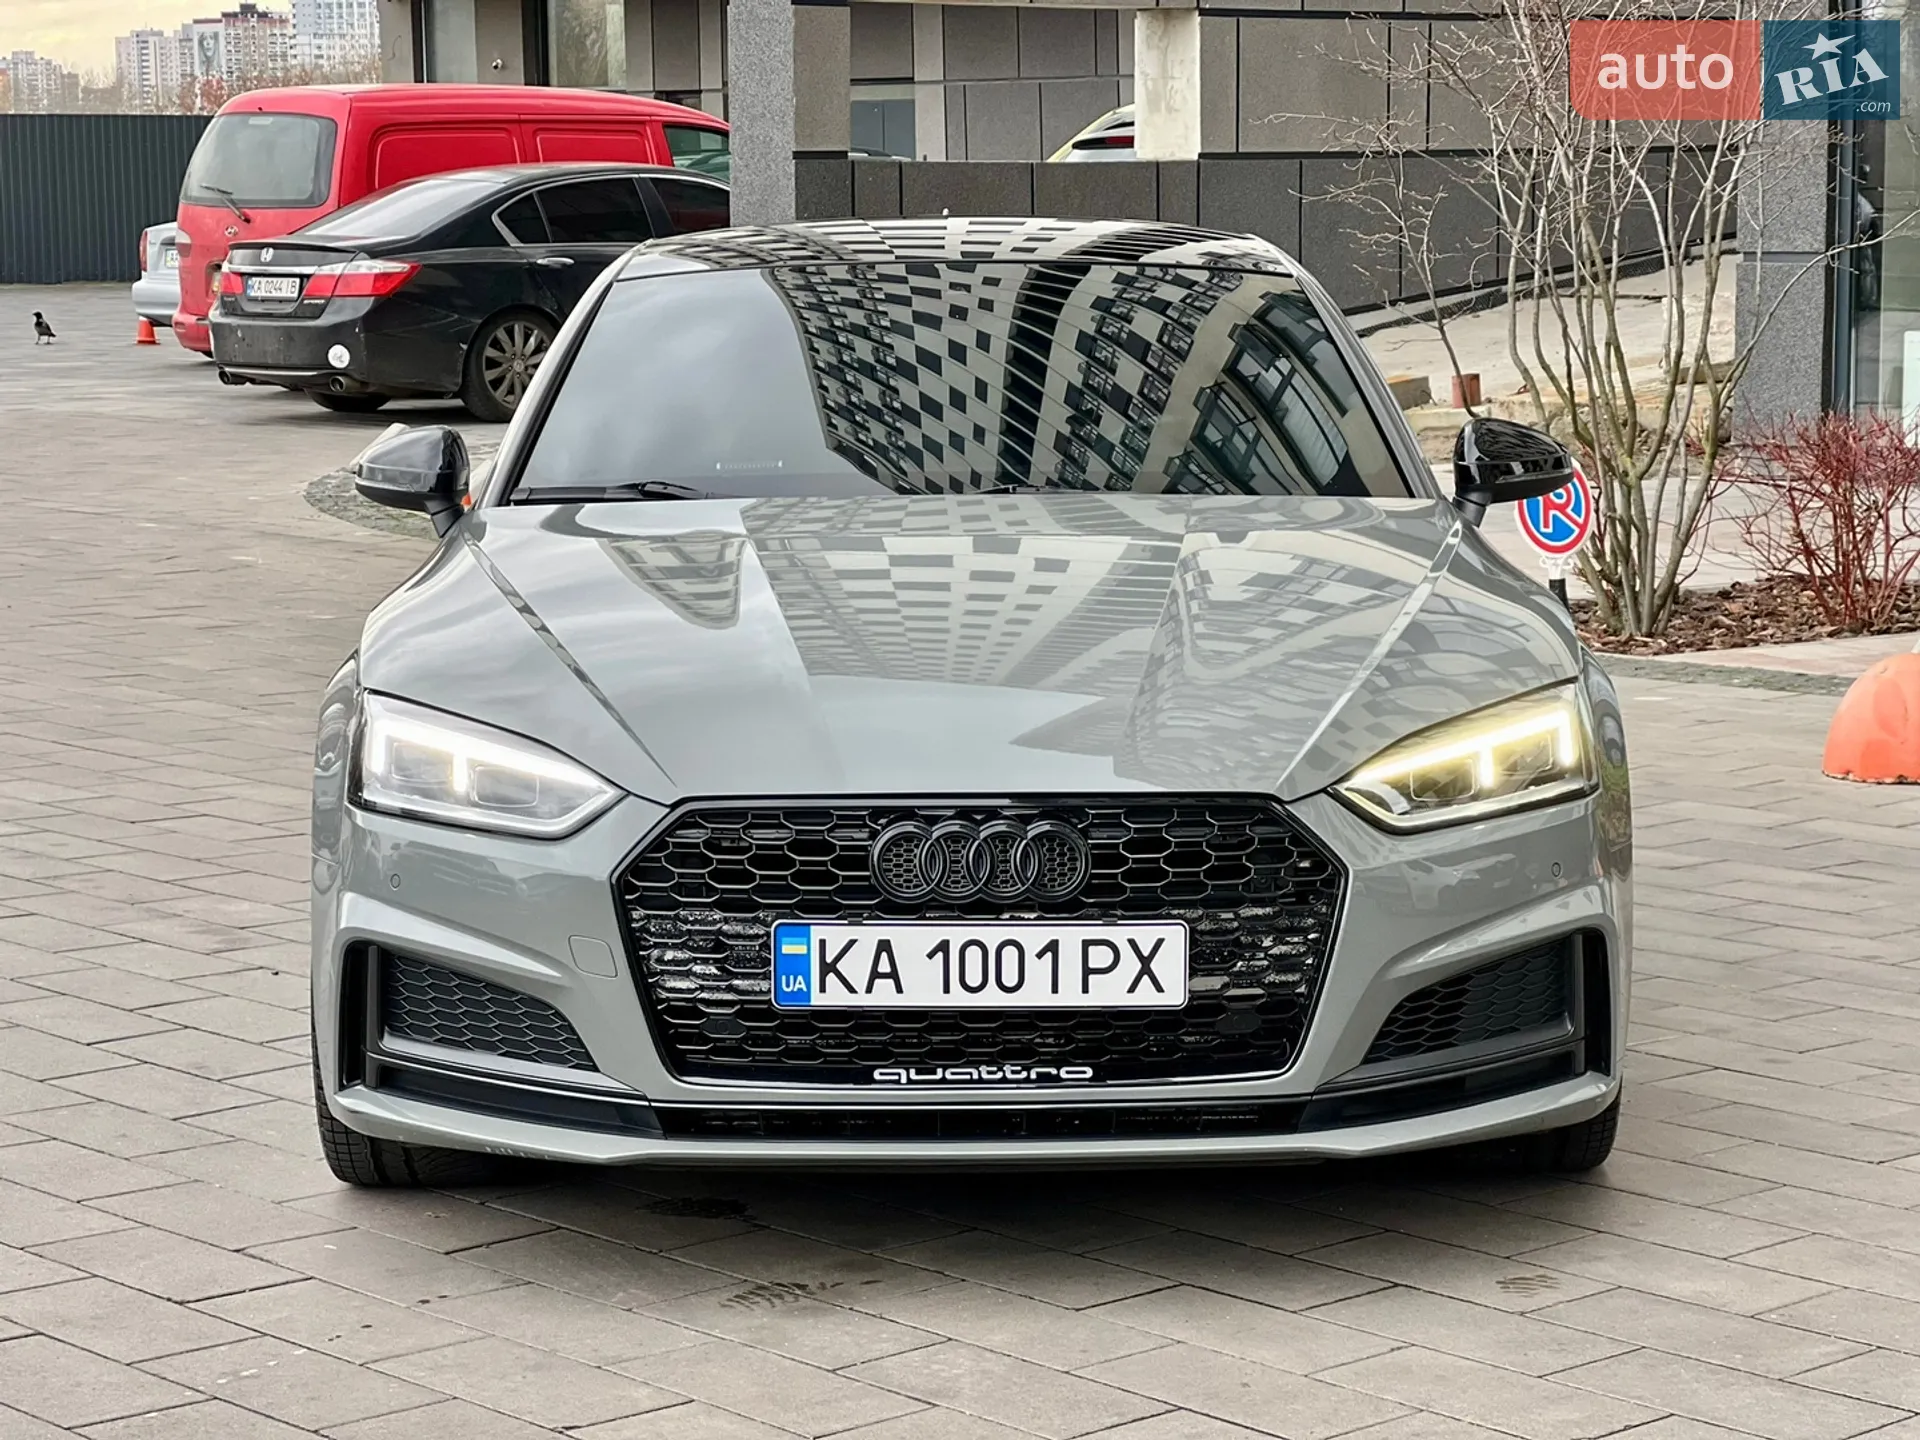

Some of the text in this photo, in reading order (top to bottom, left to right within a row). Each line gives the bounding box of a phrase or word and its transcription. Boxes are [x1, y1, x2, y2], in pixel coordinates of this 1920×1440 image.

[265, 279, 283, 294] 0244
[818, 937, 1166, 995] KA 1001 PX
[781, 975, 807, 993] UA
[873, 1064, 1094, 1084] quattro
